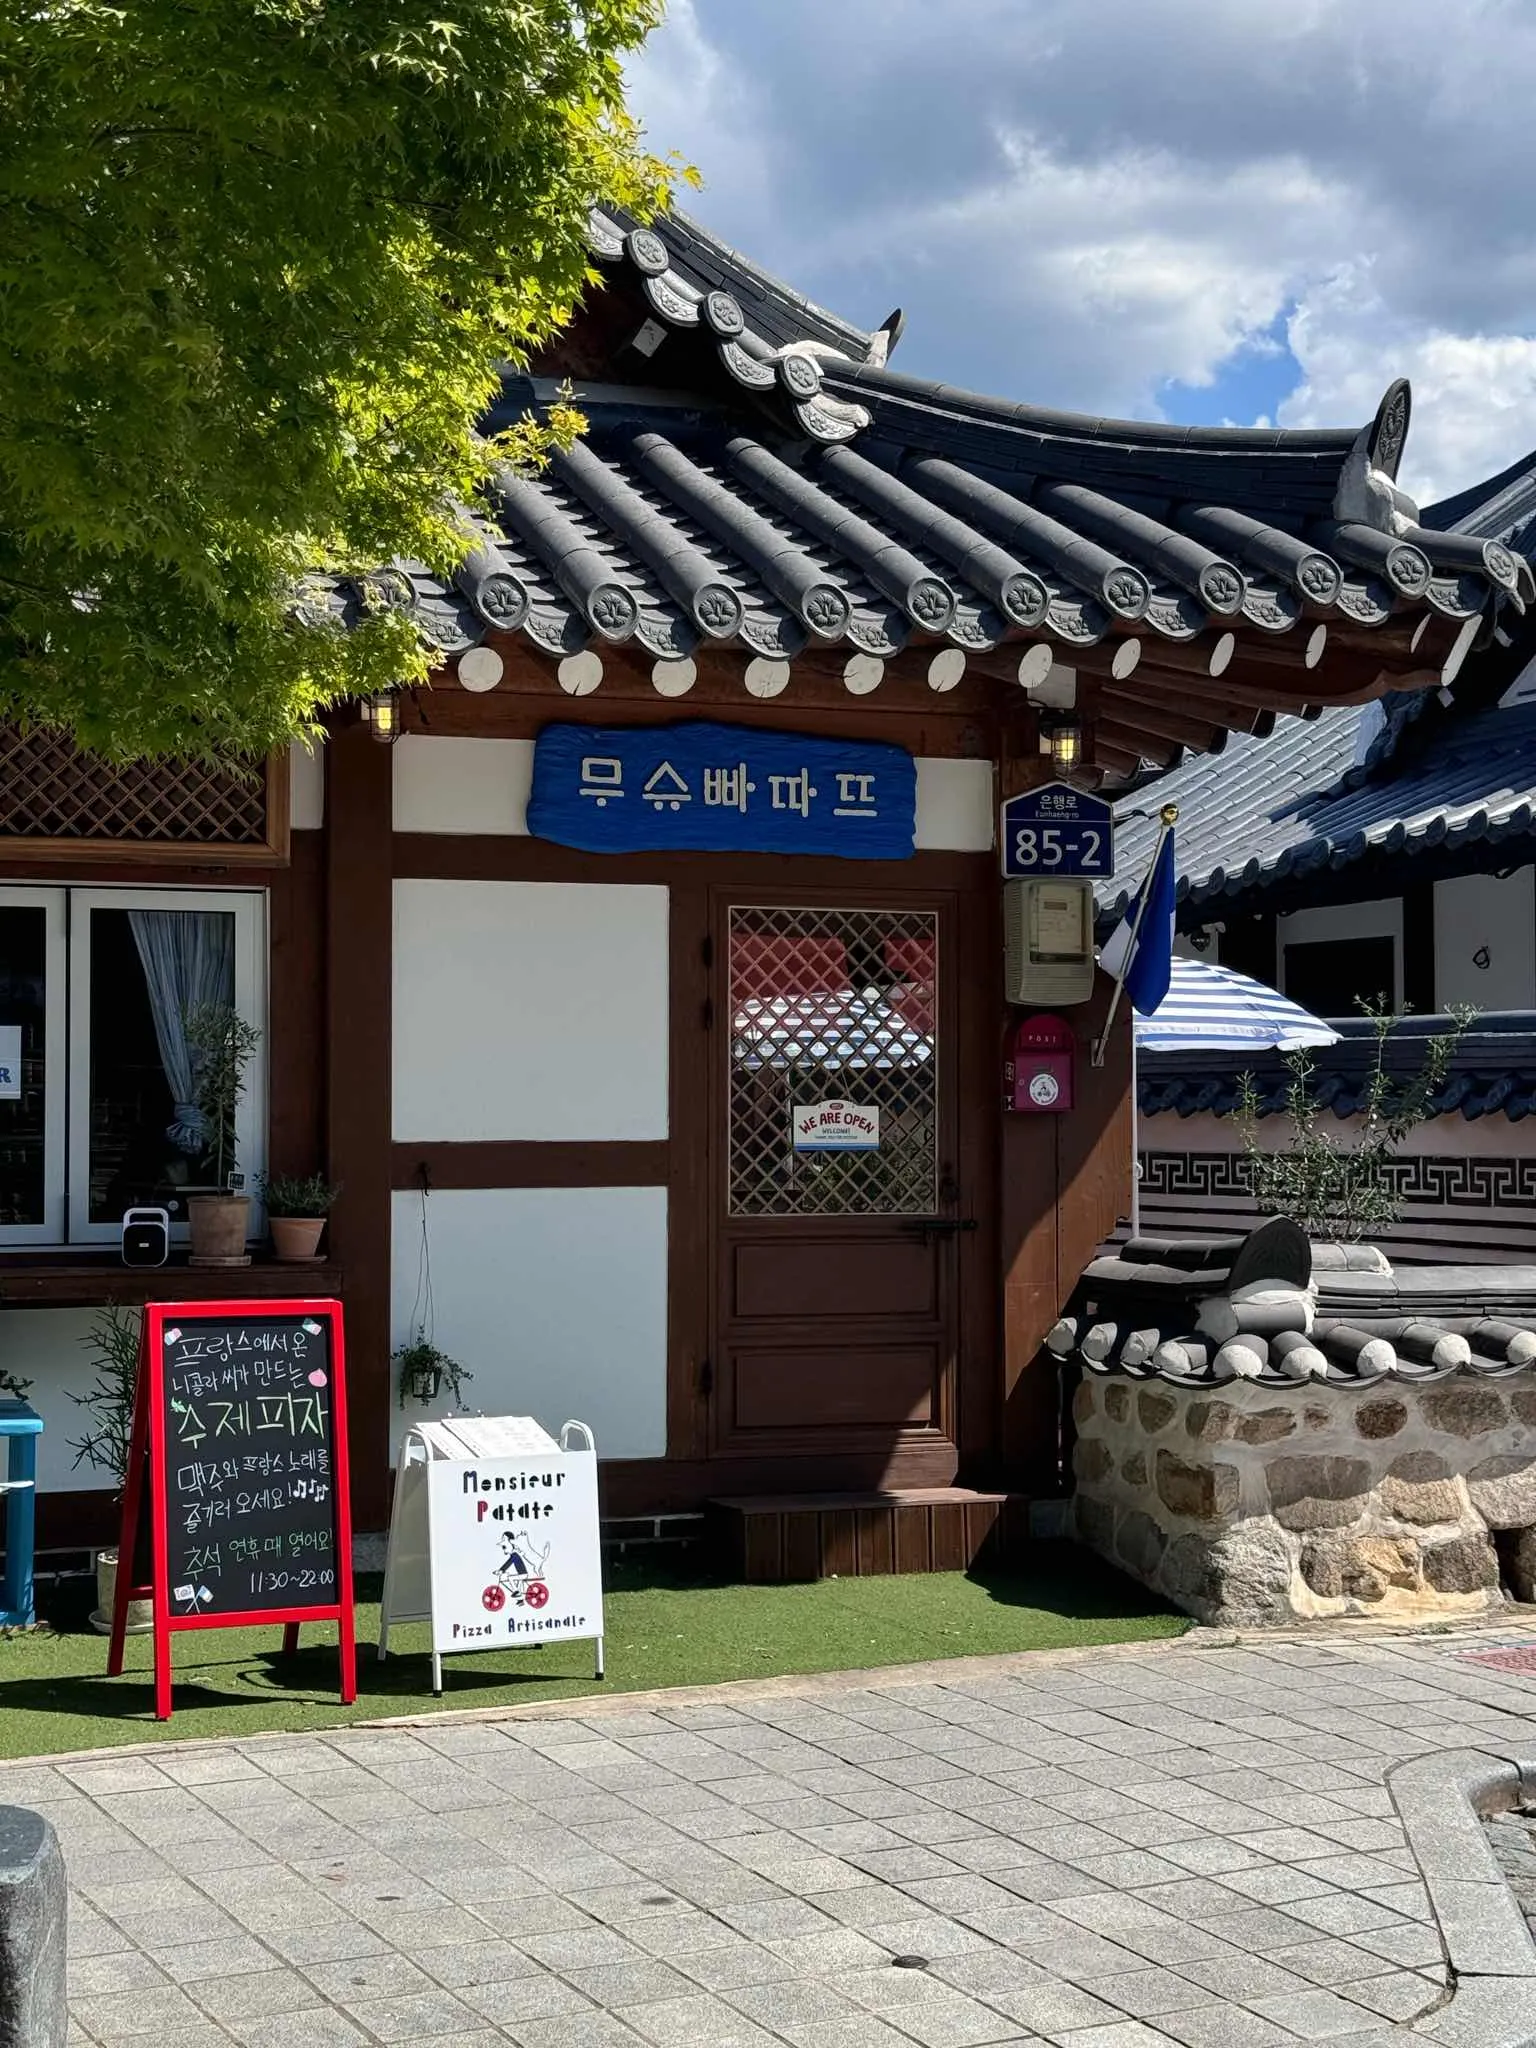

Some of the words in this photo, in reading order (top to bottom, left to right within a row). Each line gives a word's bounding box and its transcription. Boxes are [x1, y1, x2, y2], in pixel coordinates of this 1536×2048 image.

[1039, 794, 1078, 810] 은행로
[1015, 829, 1101, 867] 85-2
[1028, 1035, 1058, 1044] POST
[798, 1116, 818, 1134] WE
[819, 1112, 841, 1126] ARE
[843, 1112, 876, 1134] OPEN
[174, 1330, 288, 1367] 프랑스에서
[291, 1332, 308, 1357] 온
[172, 1370, 218, 1397] 니콜라
[222, 1363, 249, 1392] 씨가
[254, 1359, 306, 1389] 만드는
[177, 1458, 239, 1497] 맥주와
[242, 1452, 285, 1476] 프랑스
[288, 1448, 331, 1475] 노래를
[463, 1470, 566, 1494] Monsieur
[182, 1498, 231, 1534] 즐기러
[235, 1482, 292, 1514] 오세요!
[476, 1500, 554, 1523] Patate
[182, 1543, 222, 1582] 추석
[228, 1536, 262, 1563] 연휴
[250, 1569, 335, 1593] 11:30~22:00
[453, 1622, 493, 1638] Pizza
[508, 1615, 587, 1634] Artisanale
